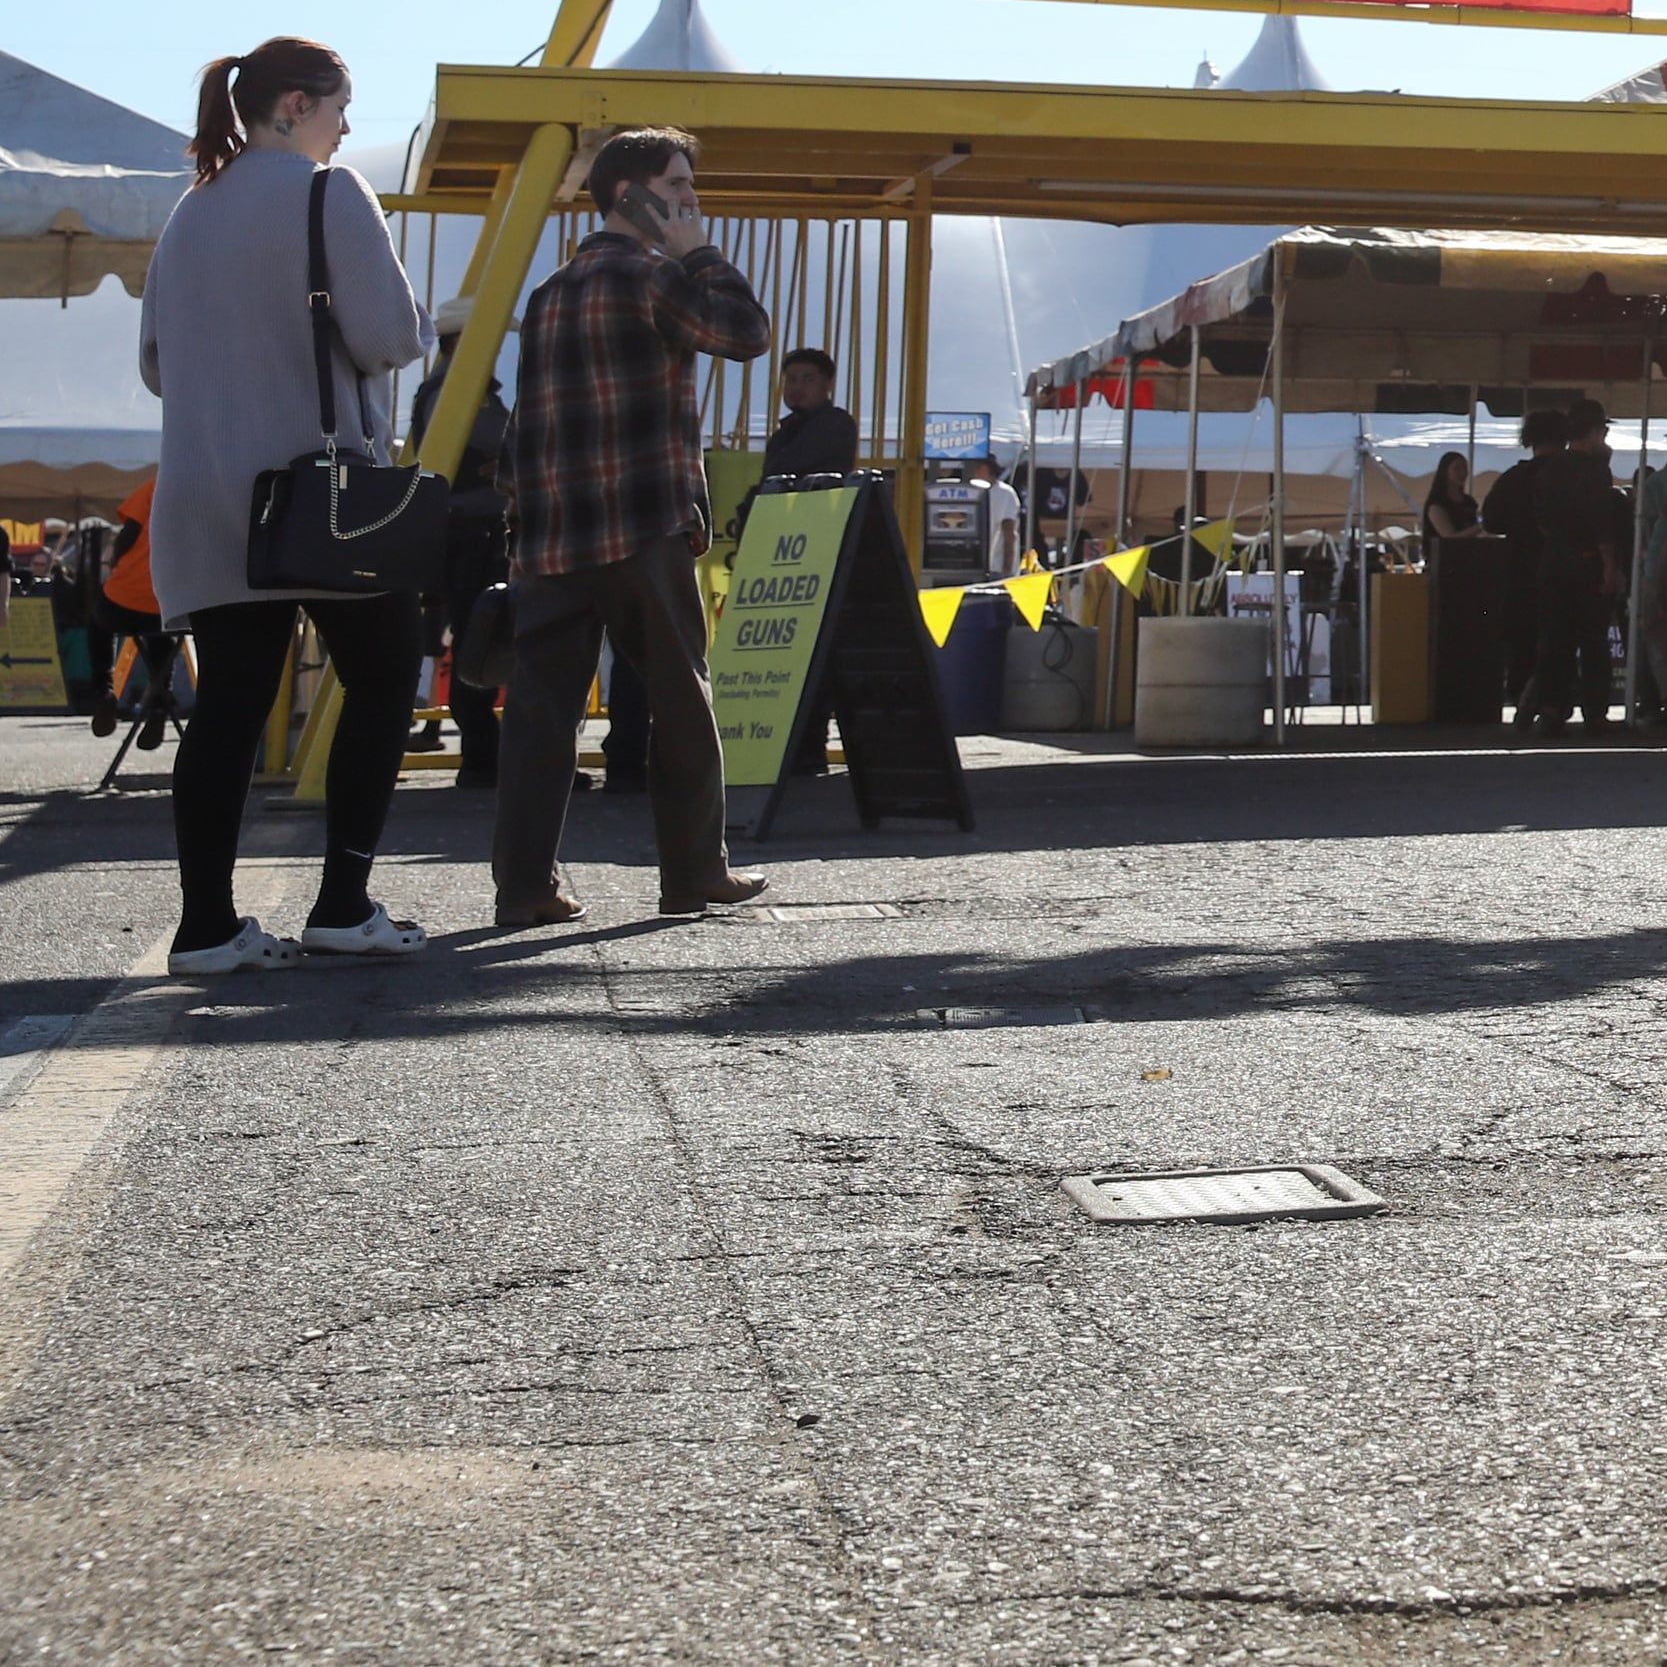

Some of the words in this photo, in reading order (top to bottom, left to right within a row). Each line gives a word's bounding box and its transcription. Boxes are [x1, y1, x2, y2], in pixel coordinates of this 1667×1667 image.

[939, 488, 968, 499] ATM
[774, 534, 807, 561] NO
[736, 574, 820, 605] LOADED
[737, 617, 798, 646] GUNS
[717, 672, 739, 685] Past
[742, 671, 762, 684] This
[765, 670, 791, 684] Point
[750, 721, 773, 740] You
